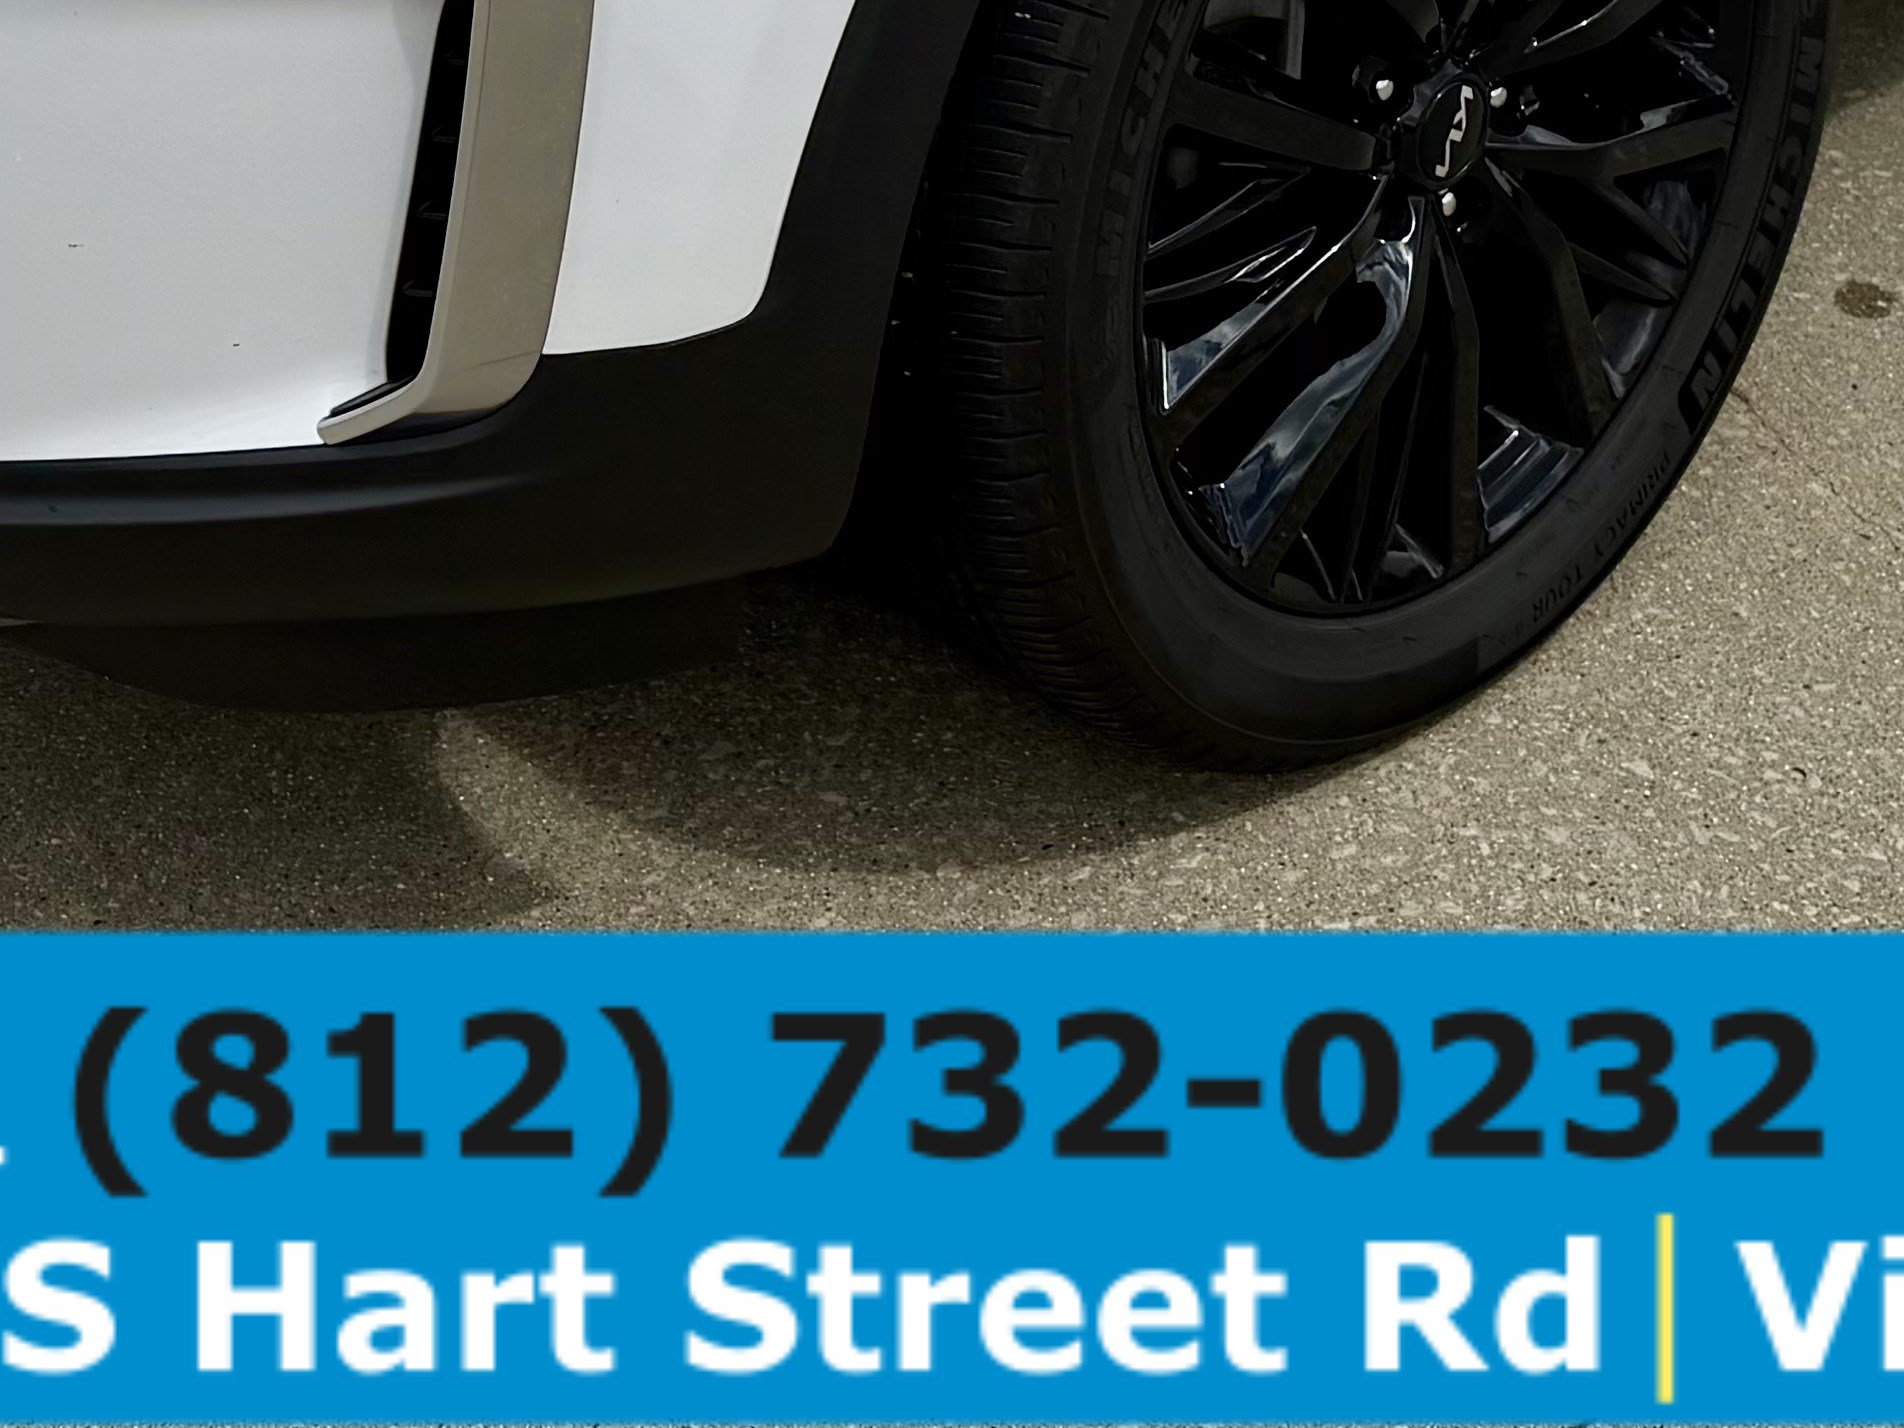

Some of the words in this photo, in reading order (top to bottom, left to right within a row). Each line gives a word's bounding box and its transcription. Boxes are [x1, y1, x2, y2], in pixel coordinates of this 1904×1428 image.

[1693, 35, 1824, 408] MICHELIN
[1594, 448, 1673, 557] PRIMACY
[1530, 563, 1584, 623] TOUR
